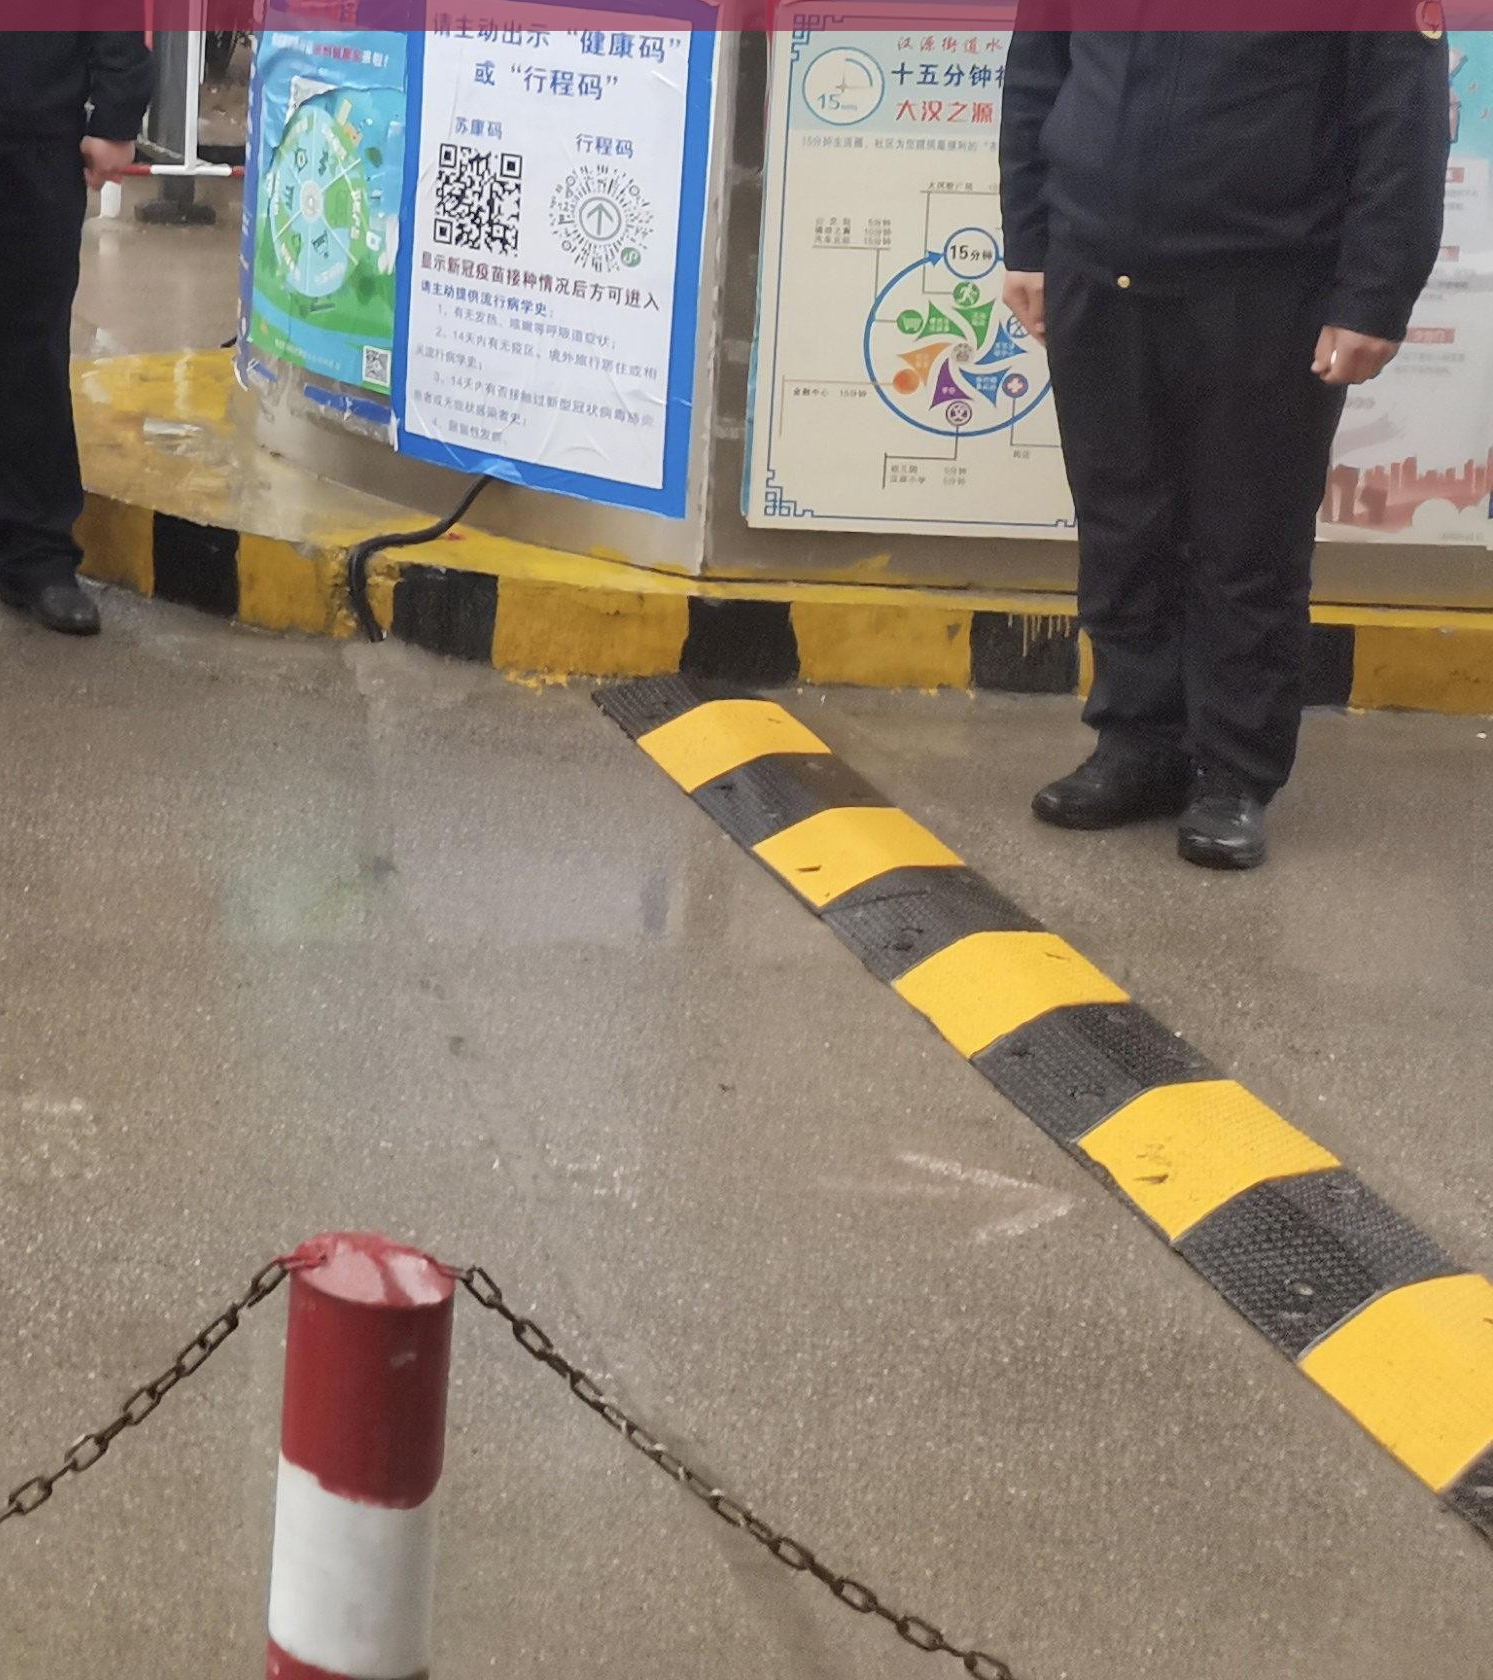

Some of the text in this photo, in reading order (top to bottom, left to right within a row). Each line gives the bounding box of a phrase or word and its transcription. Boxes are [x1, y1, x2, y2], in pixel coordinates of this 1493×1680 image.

[474, 59, 619, 100] 或“行程码”
[896, 99, 993, 124] 大汉之源
[455, 116, 503, 141] 苏康码
[575, 132, 634, 159] 行程码
[950, 245, 992, 262] 15分钟
[421, 250, 660, 311] 显示新冠疫苗接种情况后方可进入
